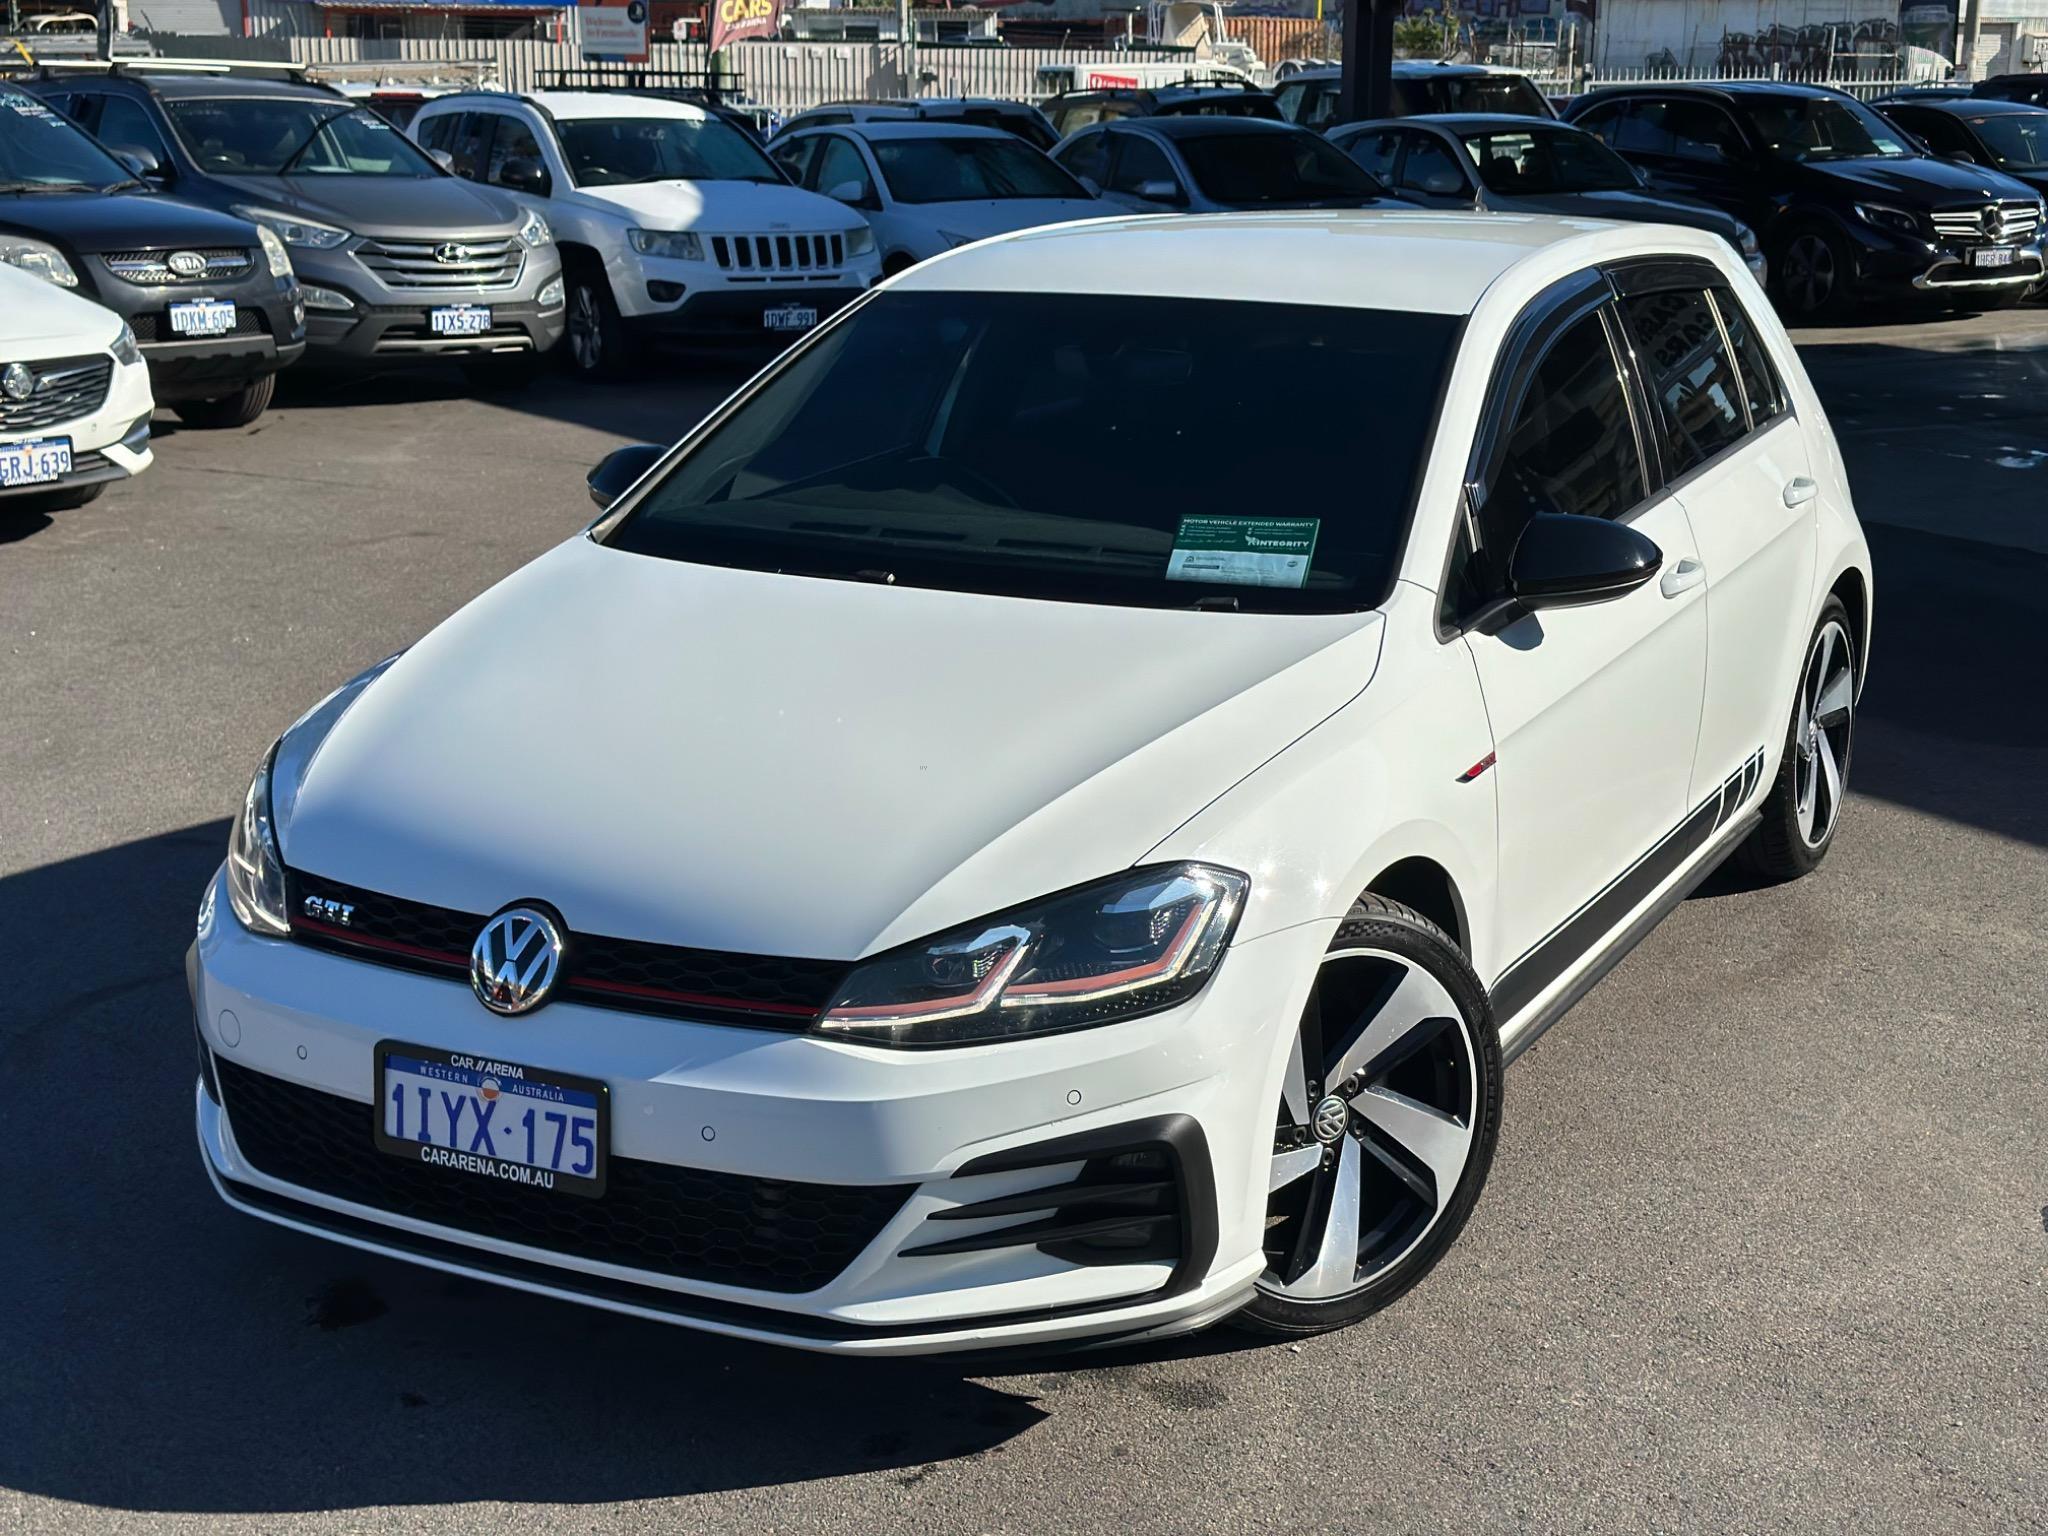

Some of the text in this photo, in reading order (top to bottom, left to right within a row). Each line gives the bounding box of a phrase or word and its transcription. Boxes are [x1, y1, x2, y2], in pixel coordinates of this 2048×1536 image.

[720, 0, 772, 23] CARS
[177, 257, 202, 270] KIA
[1256, 540, 1310, 548] INTEGRITY
[305, 896, 355, 927] GTI
[420, 1065, 565, 1103] WESTERN AUSTRALIA
[420, 1146, 555, 1189] CARARENA.COM.AU
